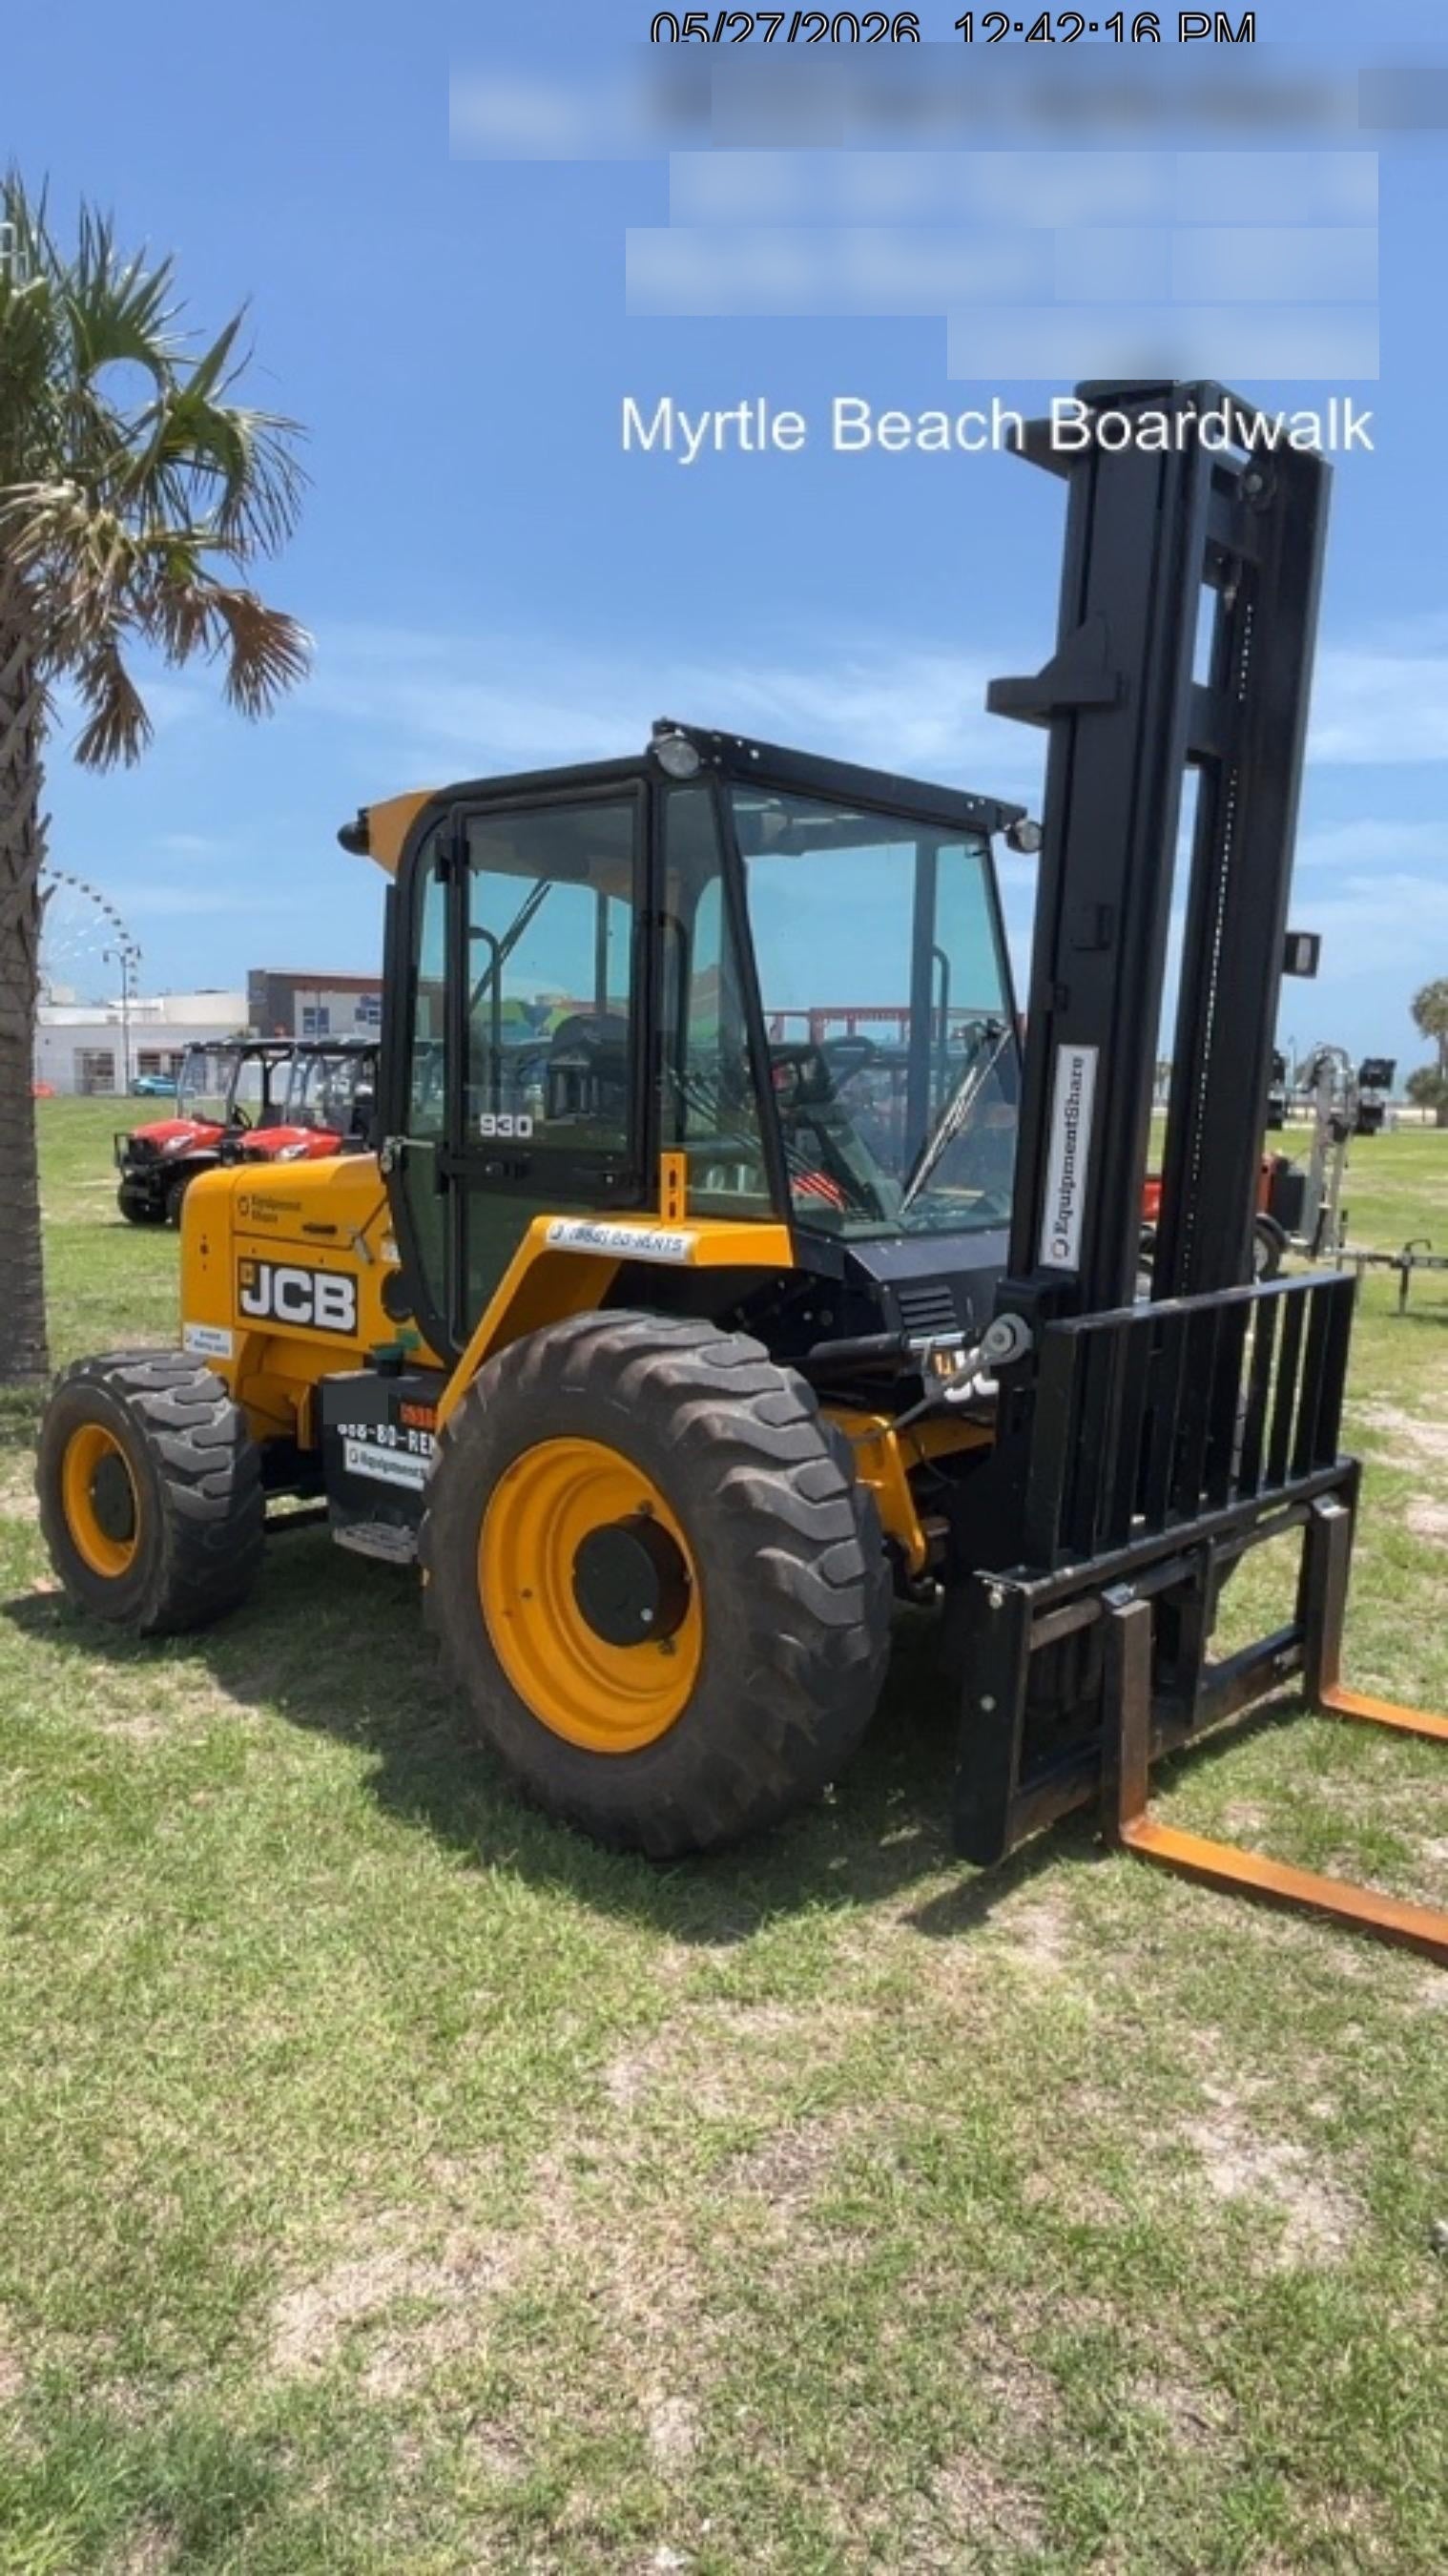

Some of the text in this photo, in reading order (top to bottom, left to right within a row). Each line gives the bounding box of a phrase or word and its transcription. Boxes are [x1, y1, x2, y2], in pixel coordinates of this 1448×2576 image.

[480, 1113, 533, 1137] 930
[1053, 1056, 1085, 1235] EquipmentShare
[240, 1264, 356, 1331] JCB
